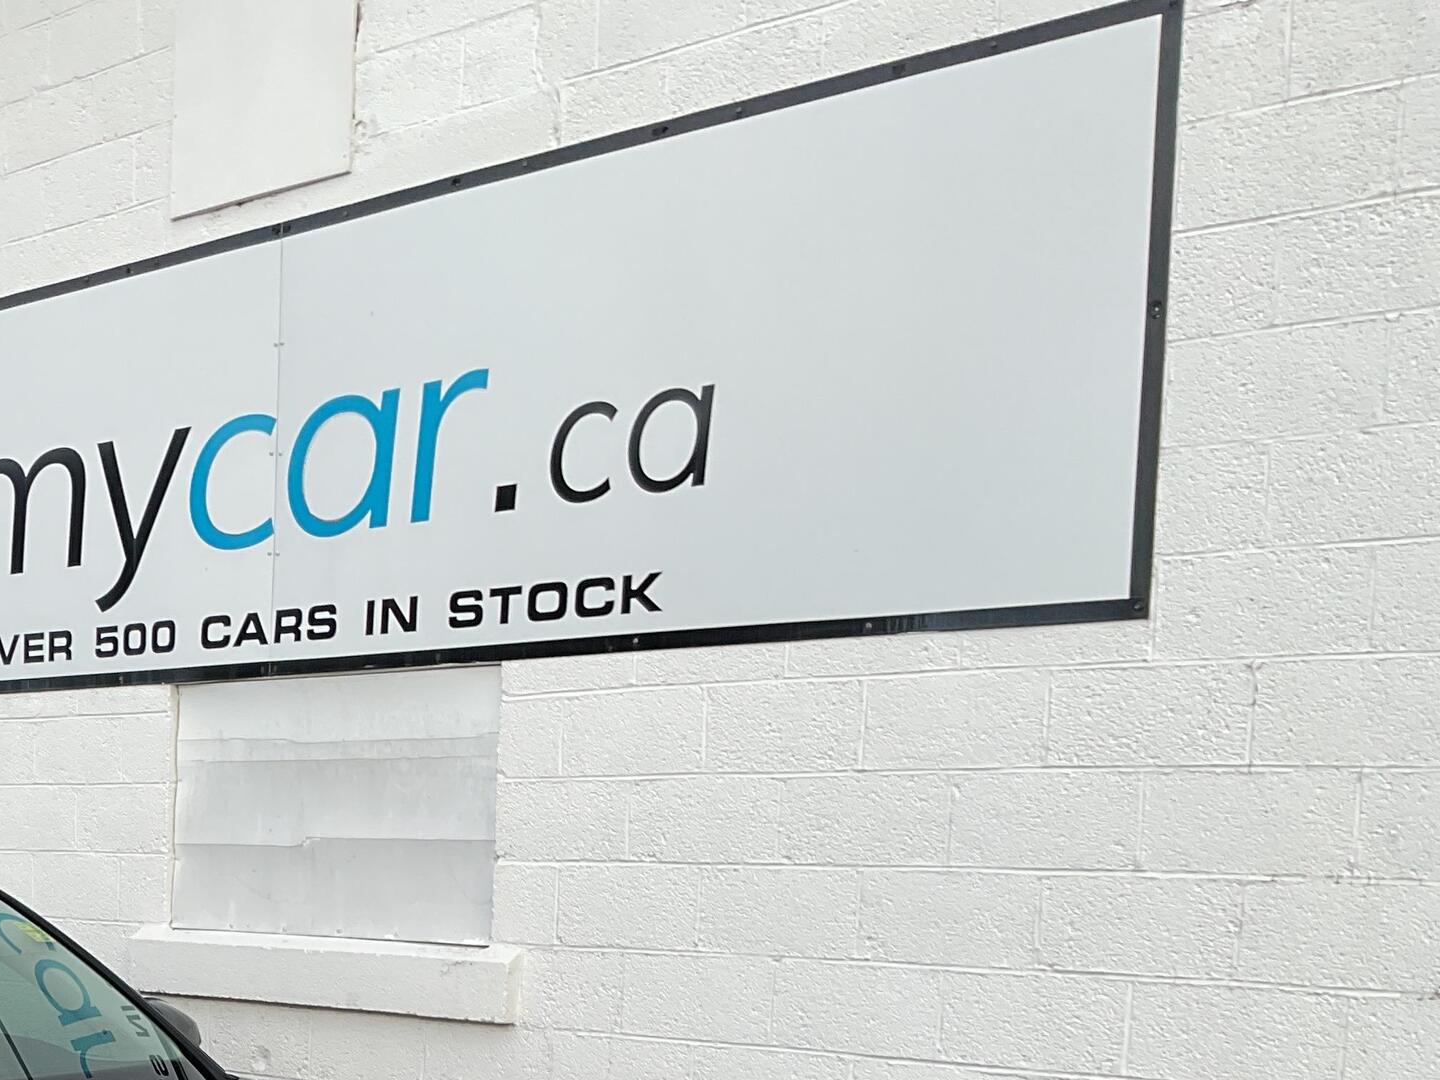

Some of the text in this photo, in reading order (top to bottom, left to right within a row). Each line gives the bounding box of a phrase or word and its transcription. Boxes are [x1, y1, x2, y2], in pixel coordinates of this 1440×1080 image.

[94, 619, 176, 655] 500
[200, 604, 338, 650] CARS
[364, 597, 420, 637] IN
[448, 571, 663, 629] STOCK
